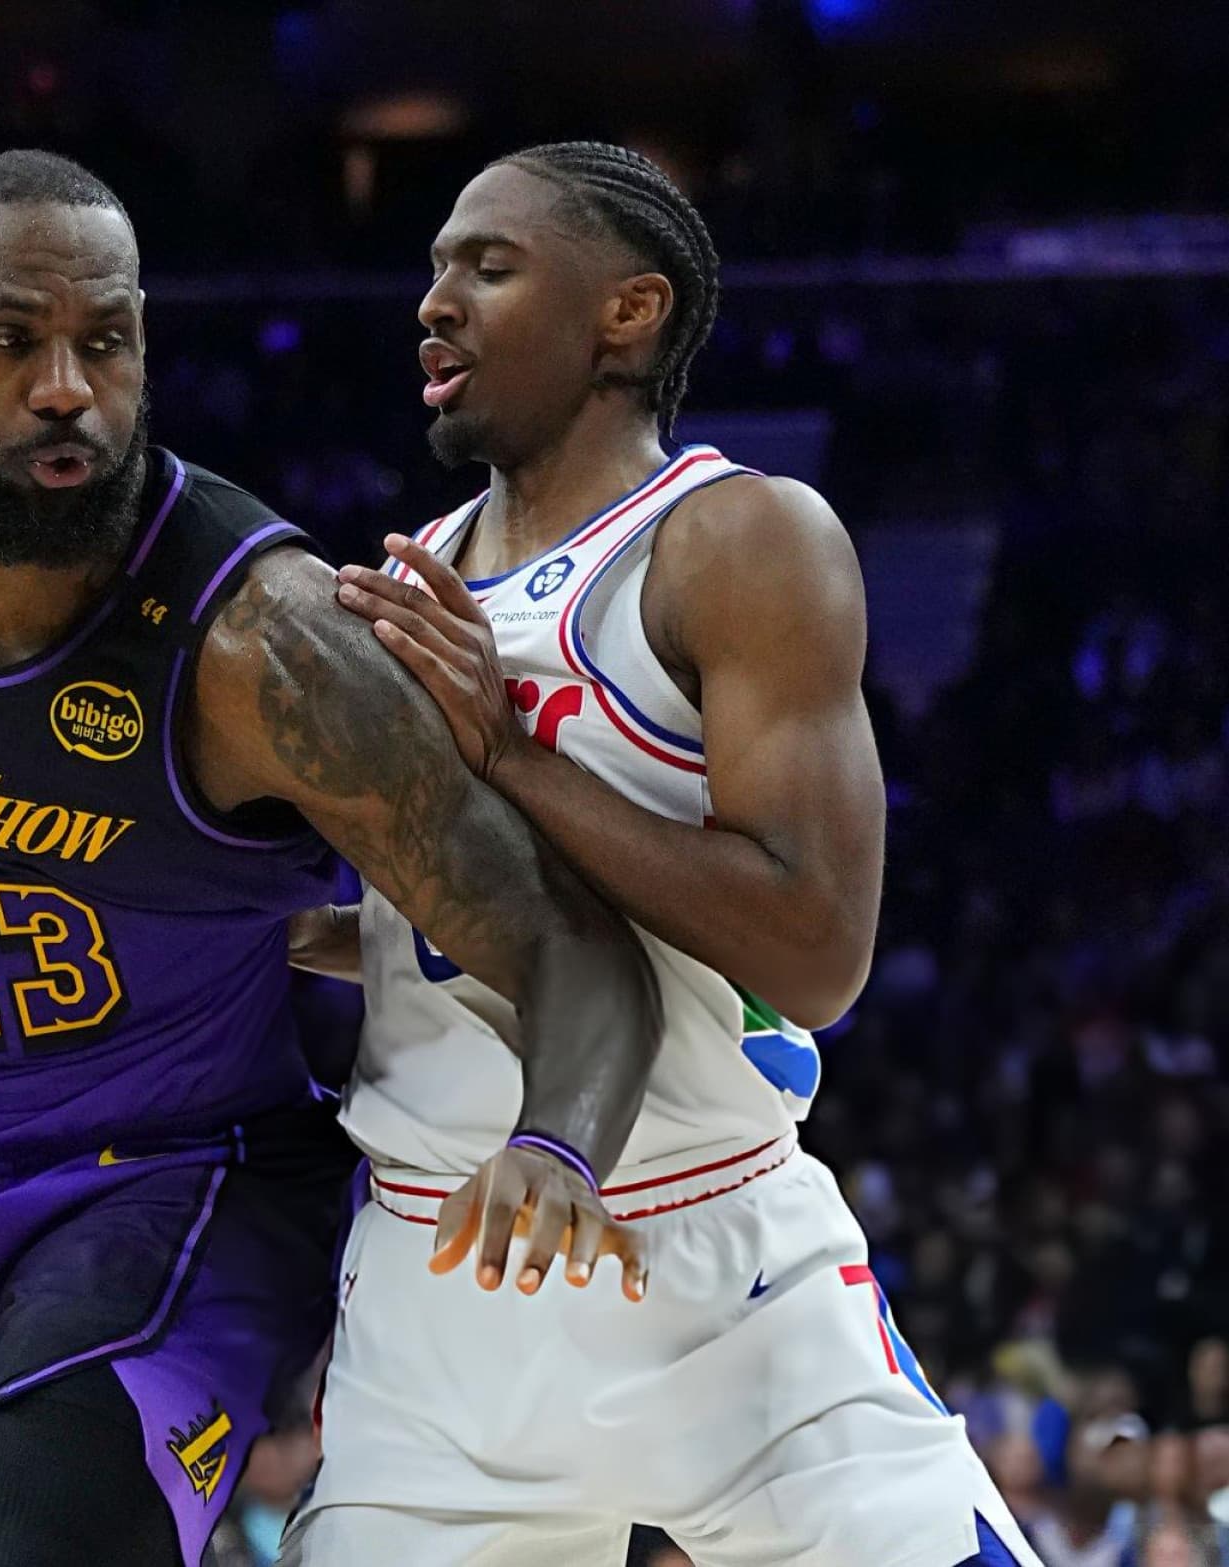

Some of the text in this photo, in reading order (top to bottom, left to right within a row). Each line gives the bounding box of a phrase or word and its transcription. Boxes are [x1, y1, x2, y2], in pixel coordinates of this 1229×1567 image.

[141, 597, 168, 625] 44
[491, 609, 559, 624] crypto.com
[60, 697, 139, 742] bibigo
[72, 723, 106, 744] 비비고
